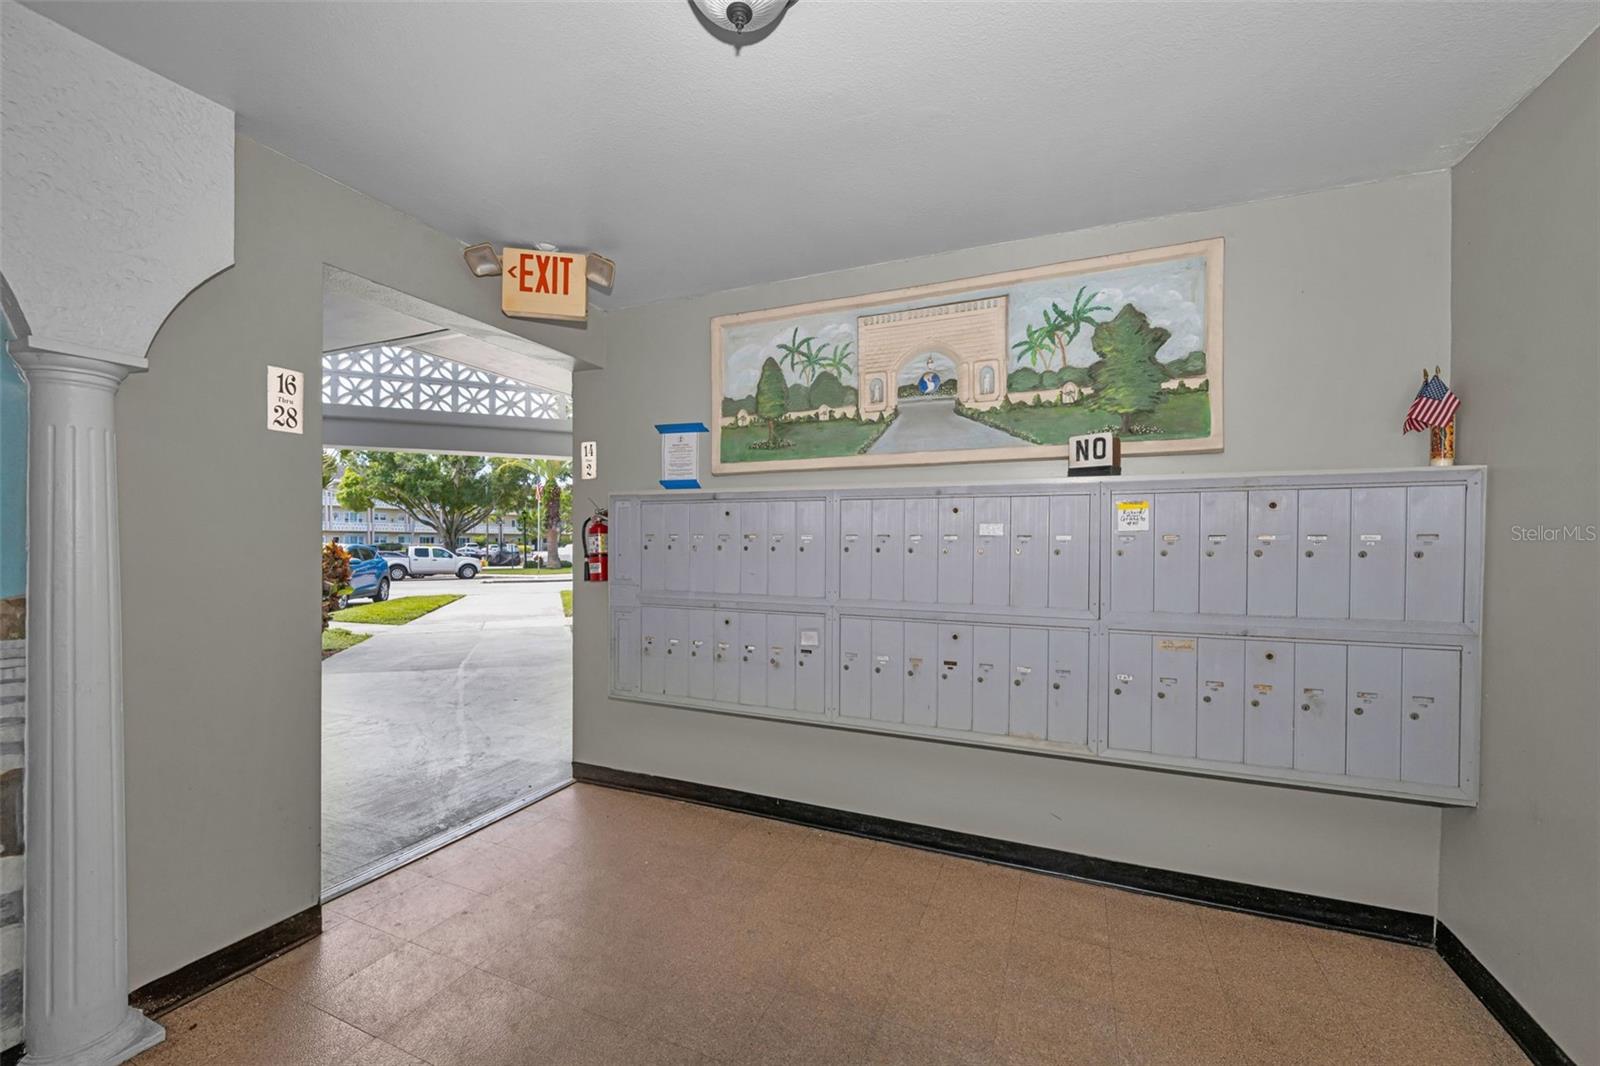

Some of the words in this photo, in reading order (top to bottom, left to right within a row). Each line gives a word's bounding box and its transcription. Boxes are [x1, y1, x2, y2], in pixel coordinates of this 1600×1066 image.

[519, 253, 573, 295] EXIT
[276, 373, 297, 396] 16
[277, 396, 294, 405] Thru
[273, 405, 298, 429] 28
[584, 444, 593, 457] 14
[1076, 437, 1106, 462] NO
[586, 463, 592, 476] 2
